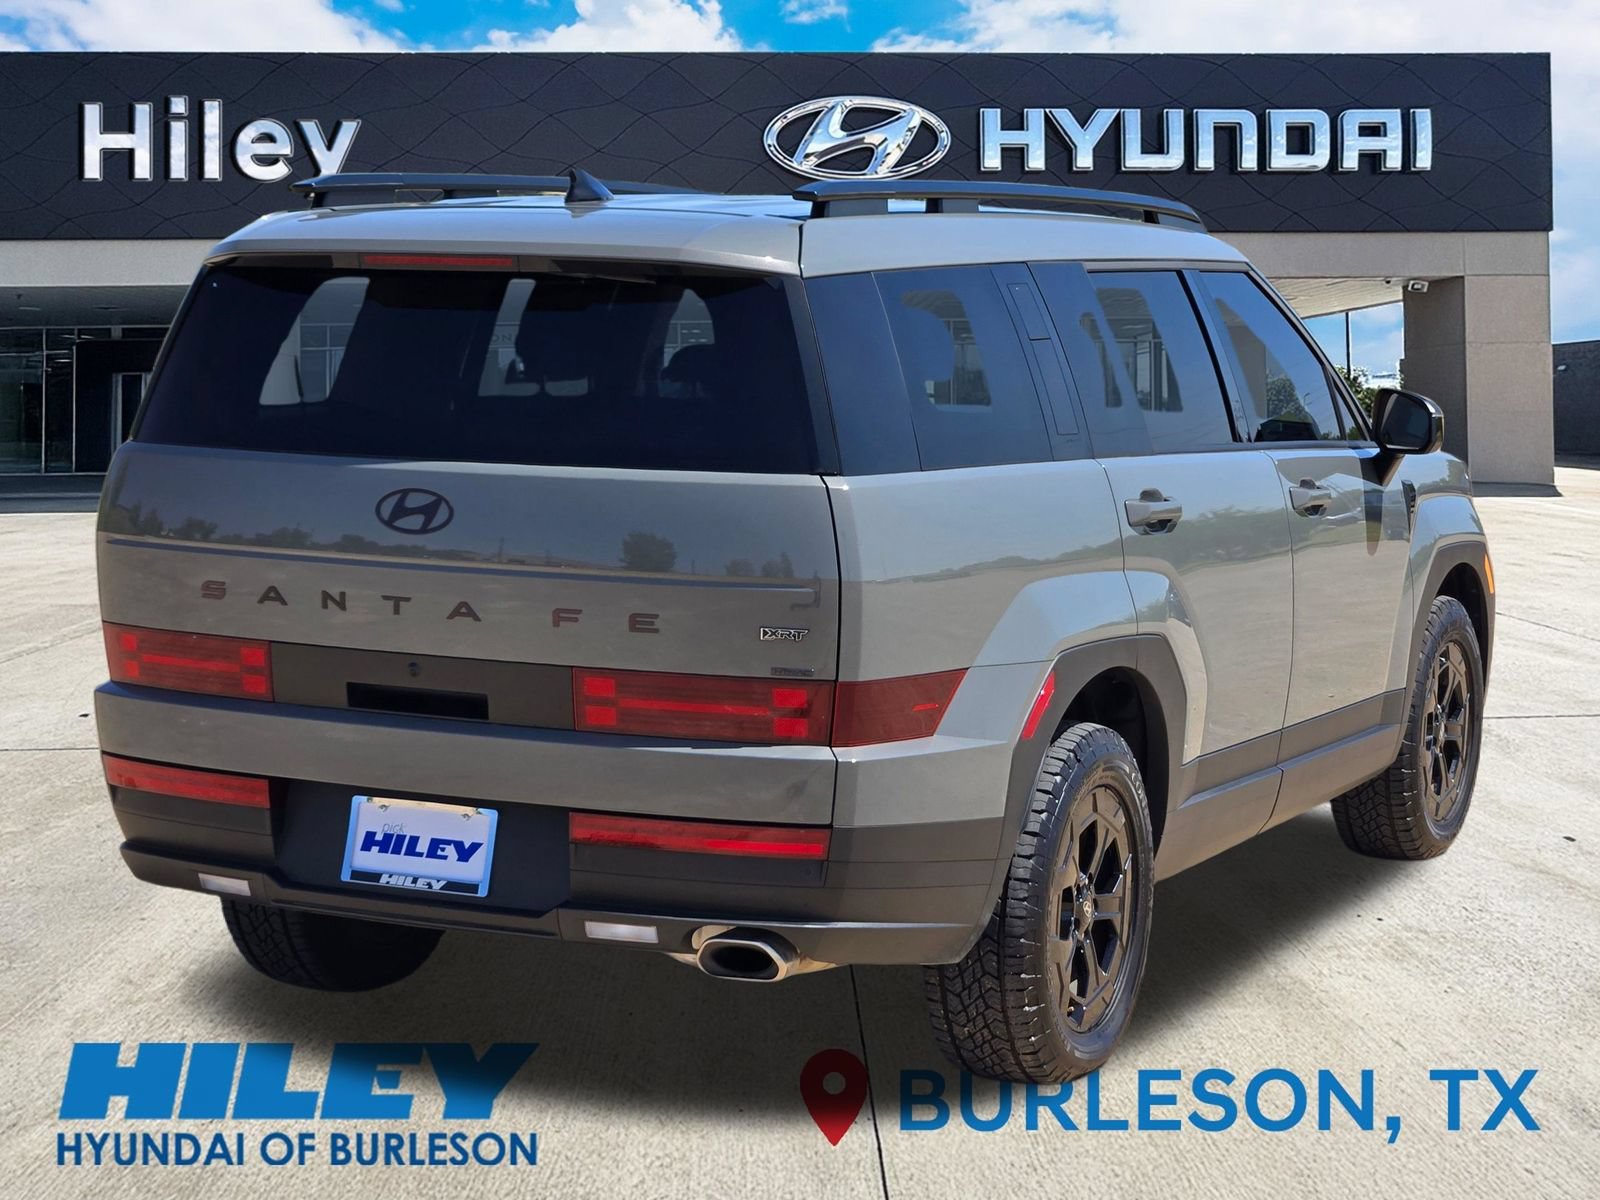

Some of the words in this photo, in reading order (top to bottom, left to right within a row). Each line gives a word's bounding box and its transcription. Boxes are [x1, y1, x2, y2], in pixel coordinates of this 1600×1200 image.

[79, 95, 362, 183] Hiley
[979, 107, 1433, 173] HYUNDAI
[201, 580, 483, 623] SANTA
[552, 608, 660, 634] FE
[761, 627, 809, 641] XRT
[360, 830, 484, 863] HILEY
[379, 873, 448, 890] HILEY
